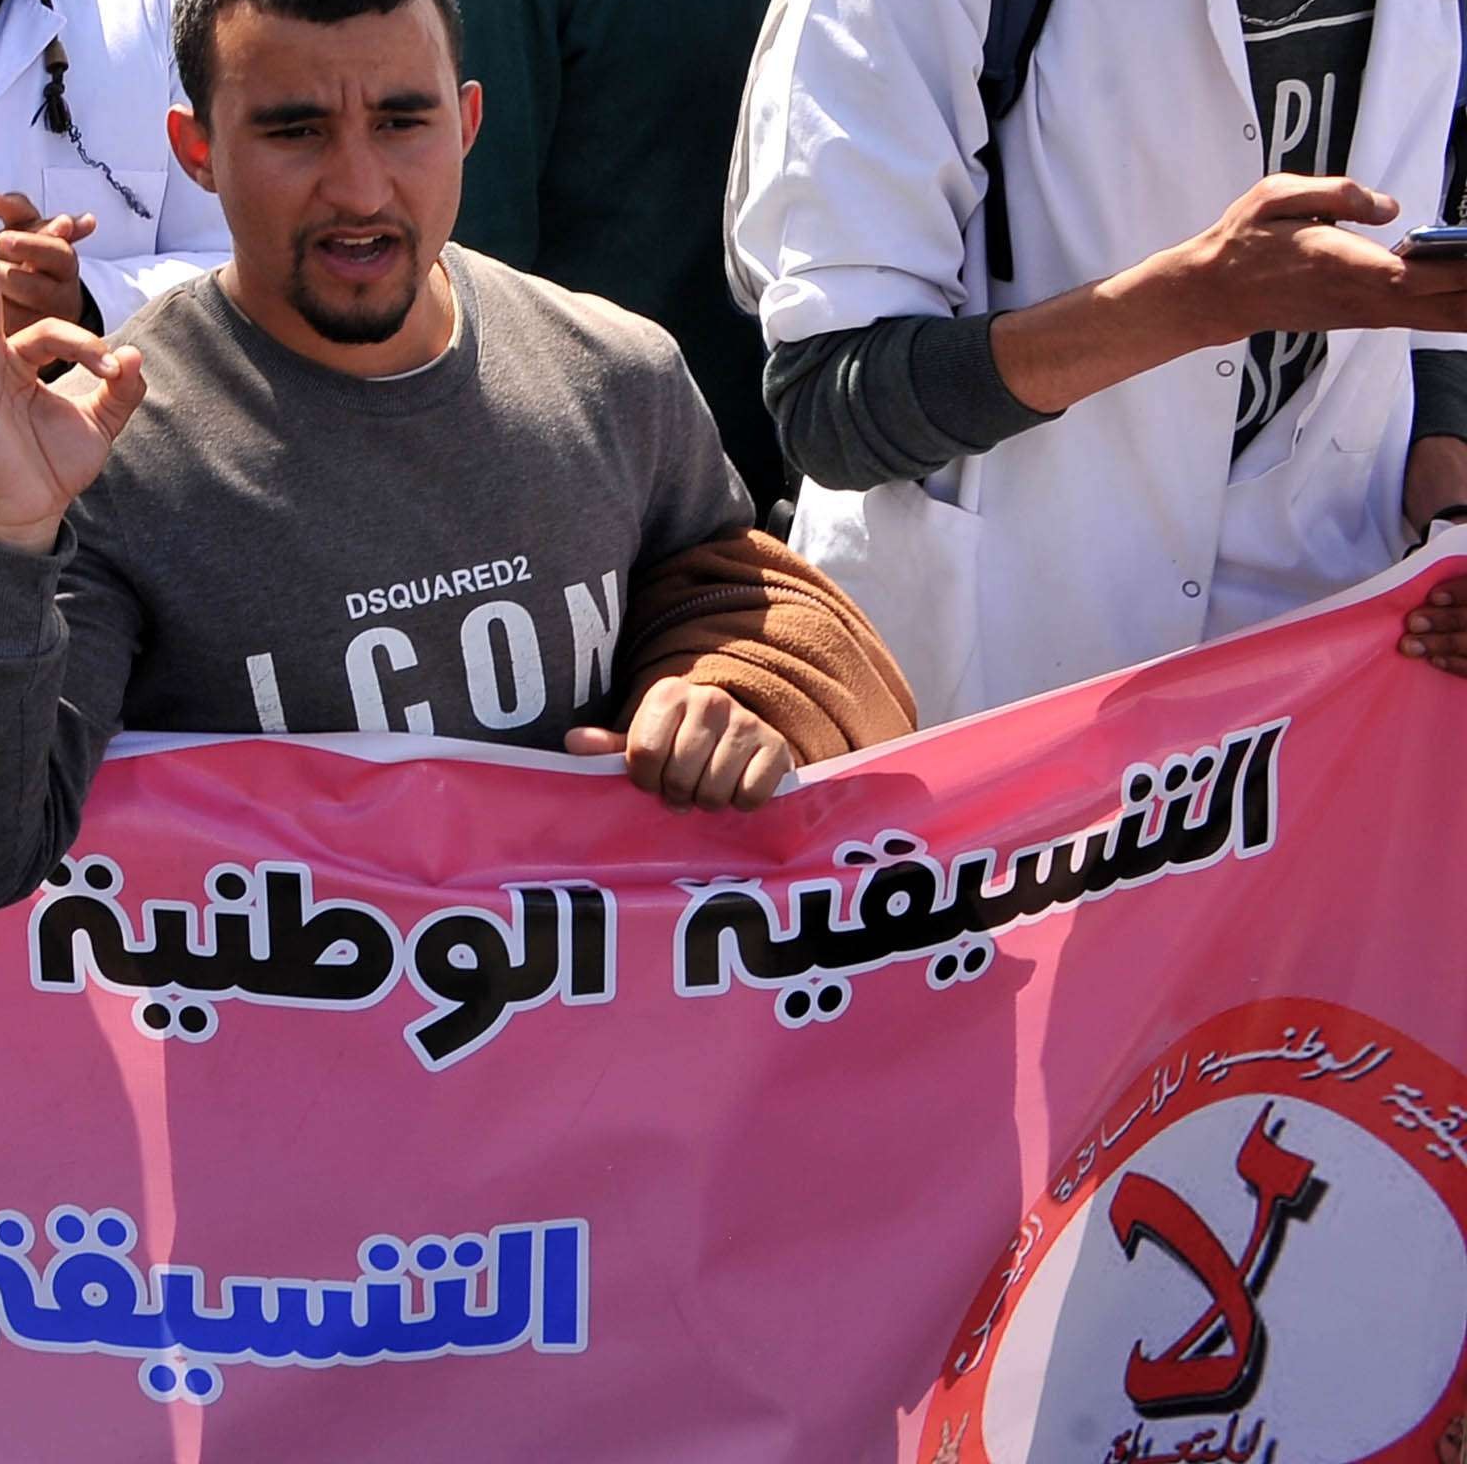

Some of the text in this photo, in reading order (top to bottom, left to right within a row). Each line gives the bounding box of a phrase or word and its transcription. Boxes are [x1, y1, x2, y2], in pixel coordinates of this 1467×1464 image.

[344, 555, 532, 621] DSQUARED2
[35, 861, 610, 1064] الوطنية
[681, 720, 1285, 1022] التنسيقية
[1108, 1099, 1329, 1420] لا
